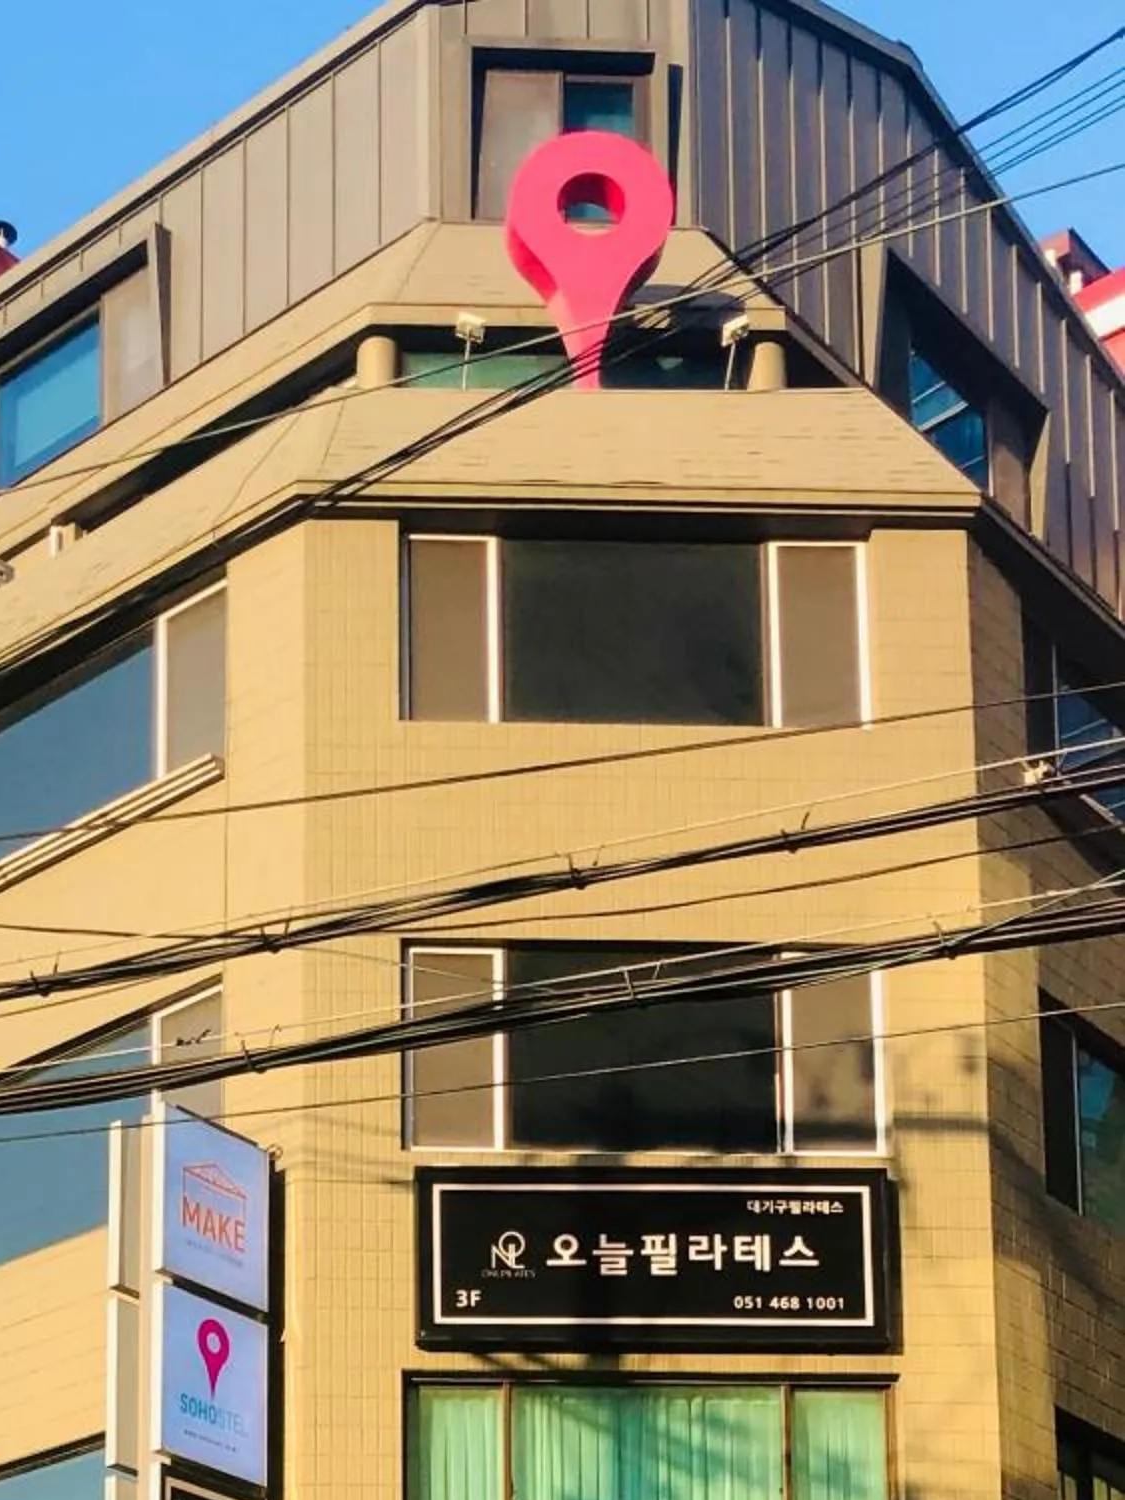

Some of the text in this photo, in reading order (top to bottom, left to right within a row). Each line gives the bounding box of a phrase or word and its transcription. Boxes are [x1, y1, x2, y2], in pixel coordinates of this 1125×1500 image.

[747, 1199, 844, 1215] 대기구필라테스
[182, 1196, 246, 1253] MAKE
[545, 1232, 820, 1278] 오늘필라테스
[456, 1290, 481, 1308] 3F
[734, 1295, 846, 1310] 051 468 1001
